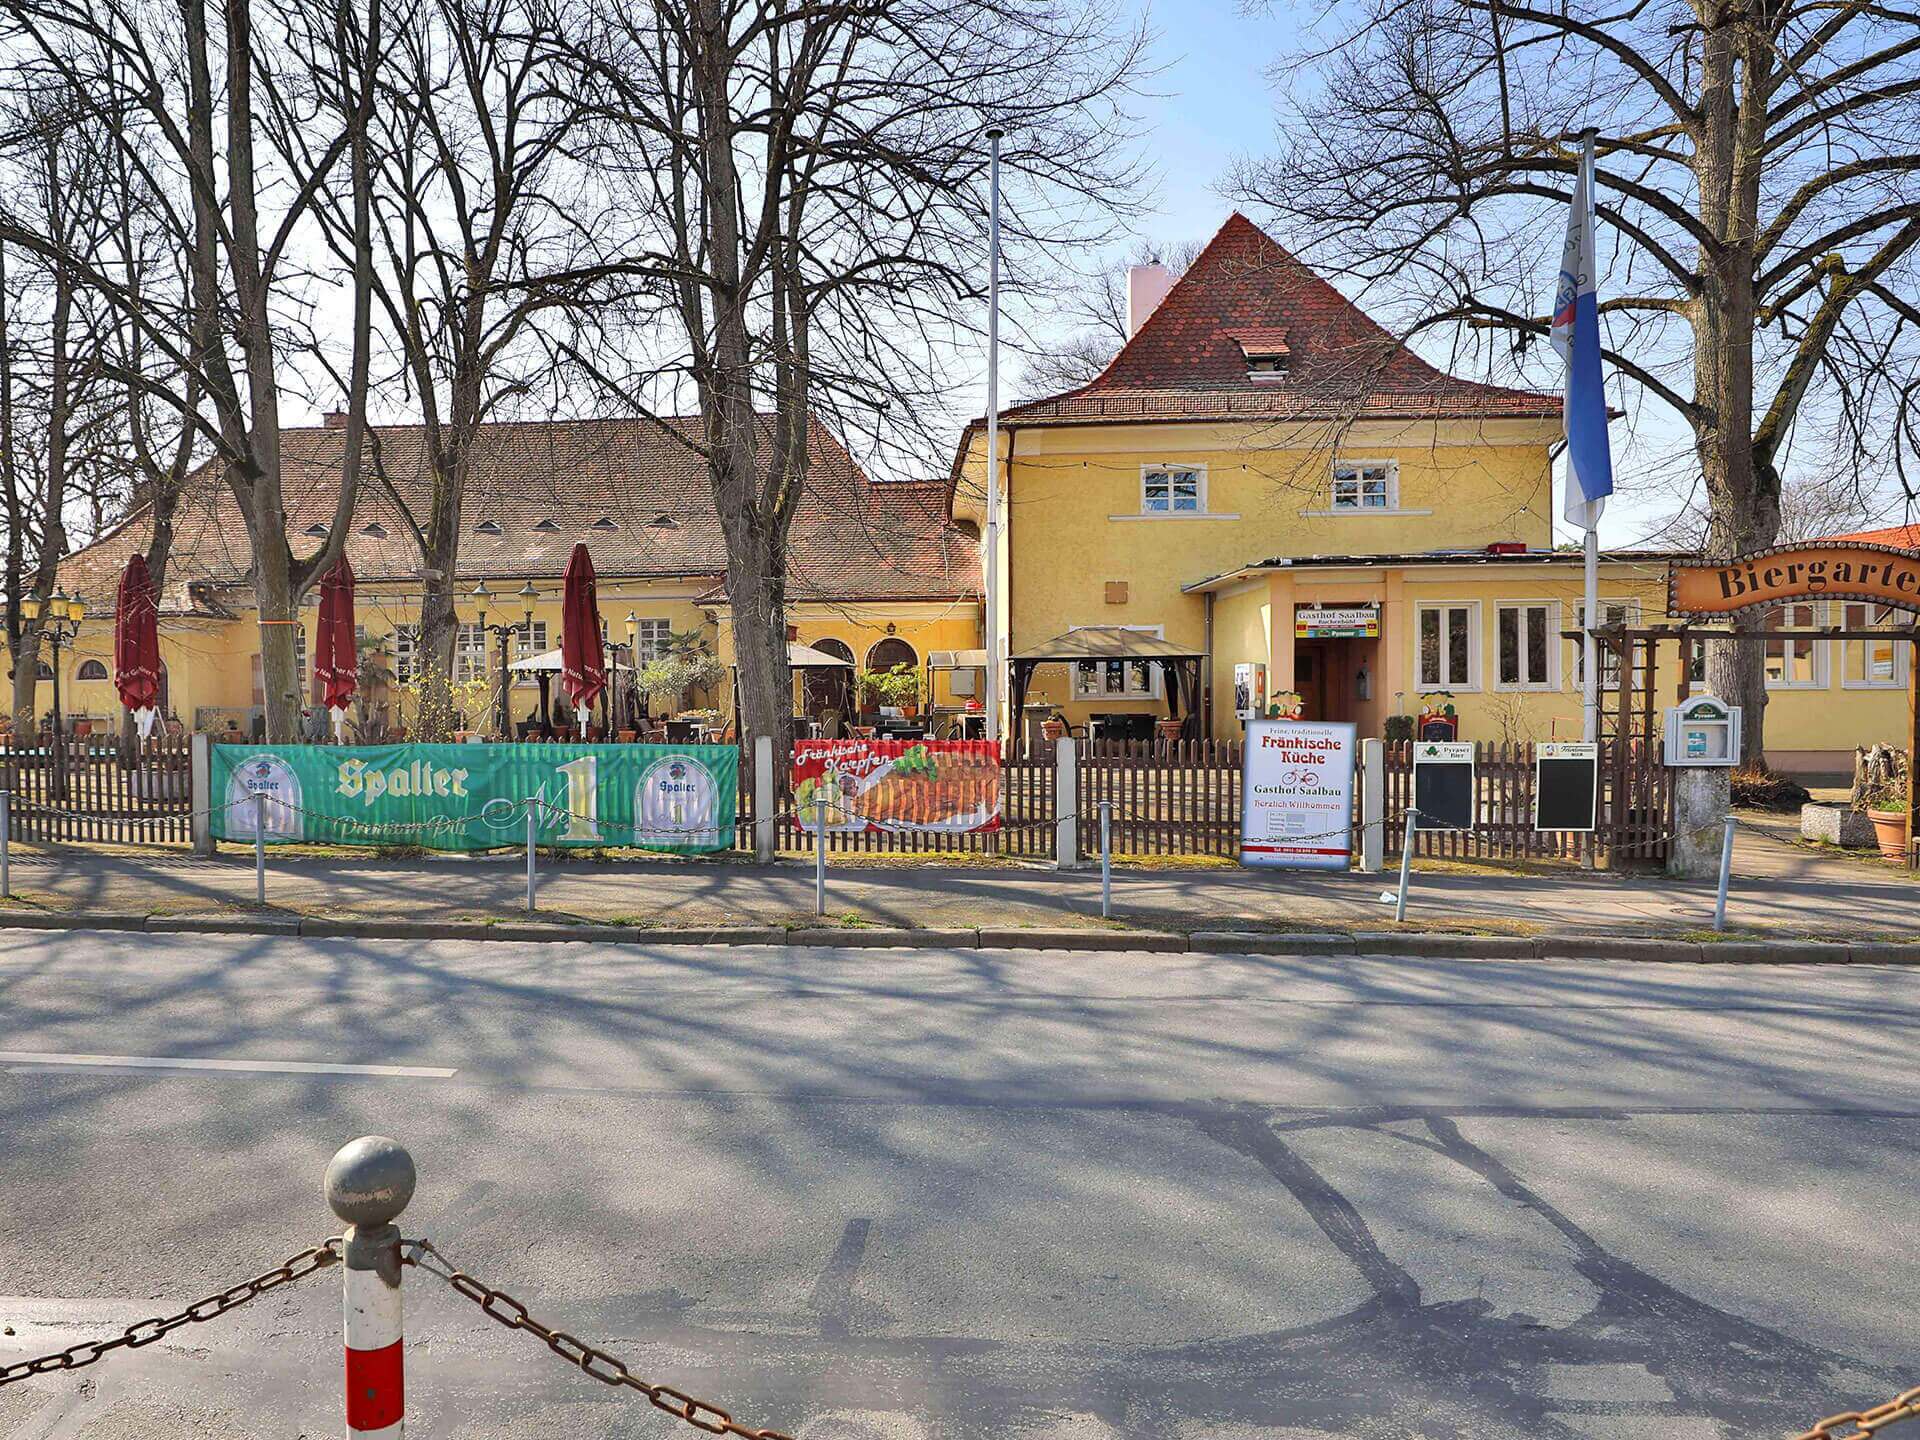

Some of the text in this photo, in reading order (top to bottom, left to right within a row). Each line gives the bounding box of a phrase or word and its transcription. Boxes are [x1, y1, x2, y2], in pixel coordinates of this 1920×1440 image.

[1717, 560, 1920, 599] Biergarte
[1299, 611, 1375, 619] Gasthof Saalbau
[1262, 736, 1342, 750] Fränkische
[796, 742, 868, 766] Fränkische
[1281, 751, 1325, 764] Küche
[824, 752, 893, 775] Karpfen
[248, 779, 279, 790] Spalter
[335, 757, 469, 807] Spalter
[660, 780, 696, 793] Spalter
[1254, 784, 1341, 797] Gasthof Saalbau
[556, 756, 604, 841] 1
[1289, 801, 1341, 811] Willkommen
